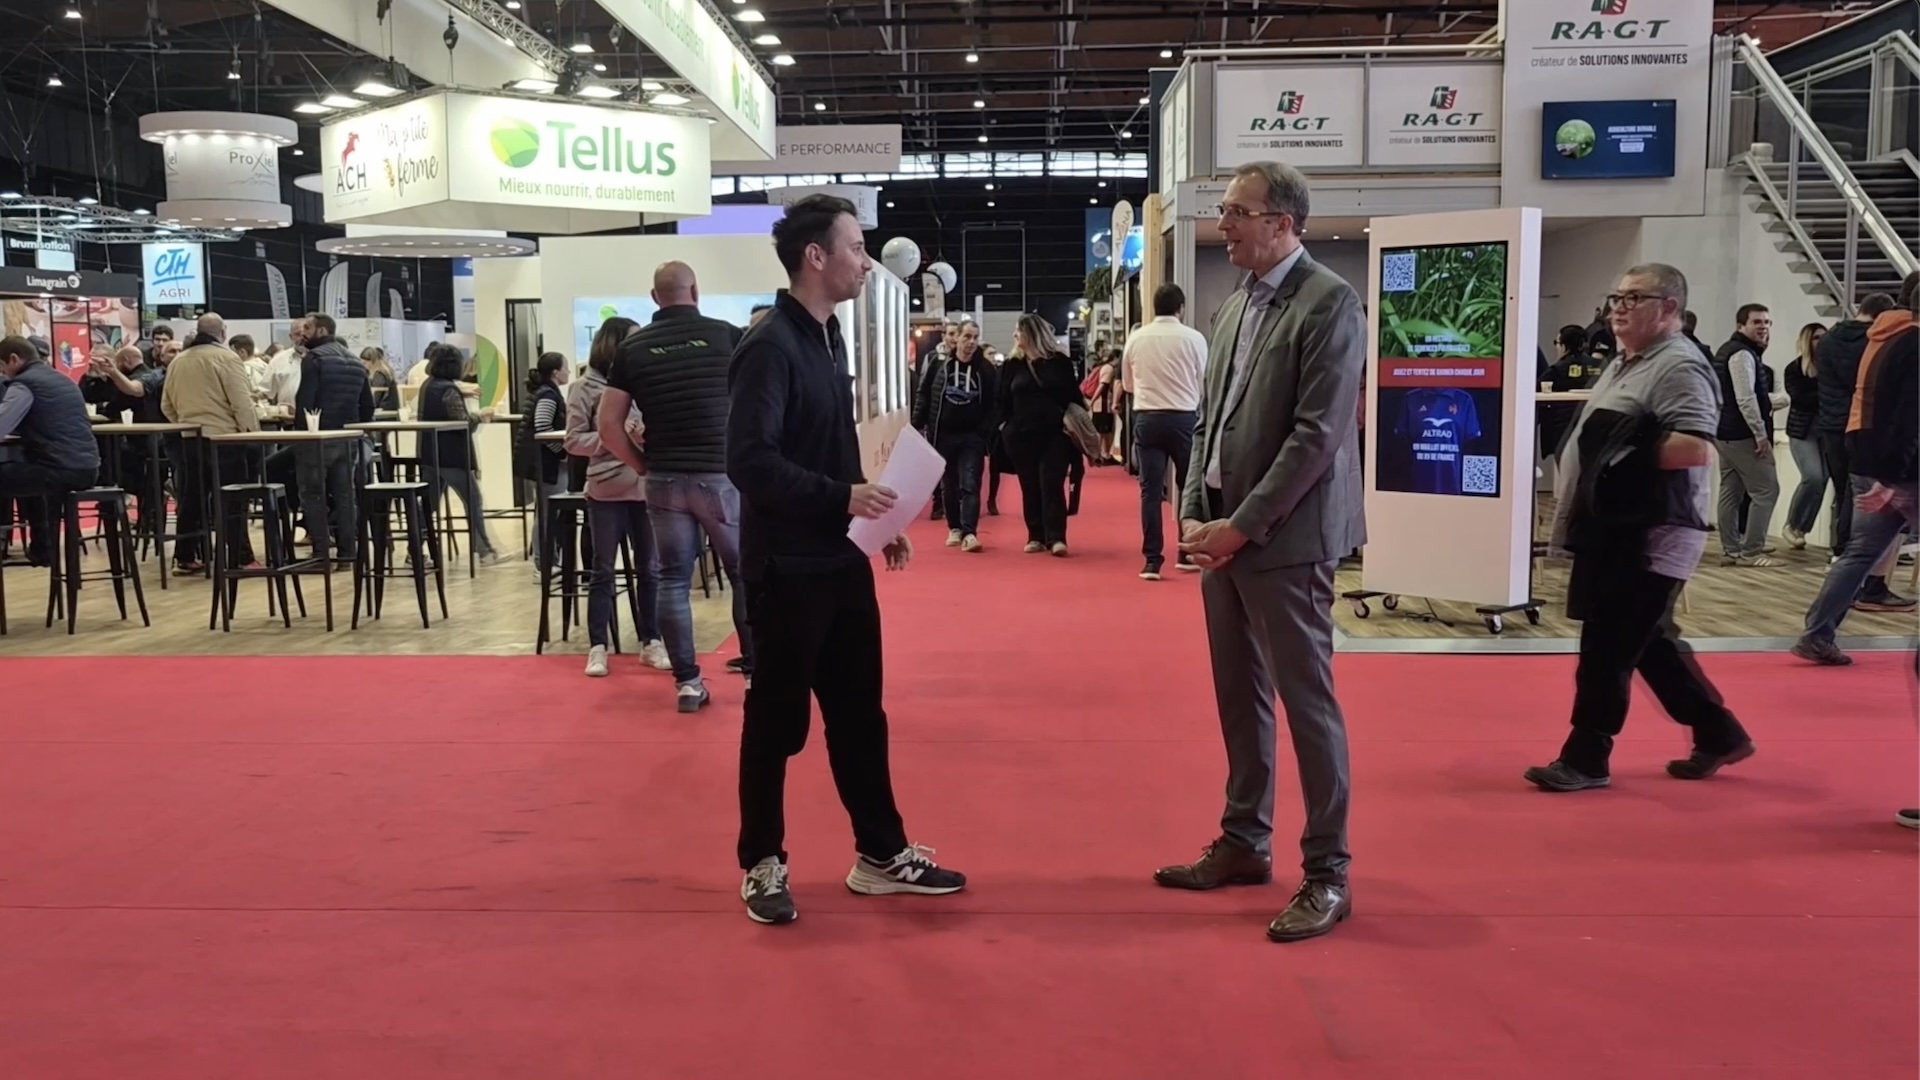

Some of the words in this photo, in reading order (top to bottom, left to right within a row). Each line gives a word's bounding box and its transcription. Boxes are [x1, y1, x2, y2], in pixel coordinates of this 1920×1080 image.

[1531, 55, 1565, 68] créateur
[1567, 55, 1578, 67] de
[1579, 53, 1629, 66] SOLUTIONS
[1631, 53, 1688, 65] INNOVANTES
[1269, 139, 1304, 149] SOLUTIONS
[1304, 139, 1343, 148] INNOVANTES
[1421, 135, 1456, 144] SOLUTIONS
[1456, 135, 1496, 143] INNOVANTES
[545, 120, 677, 177] Tellus
[790, 142, 892, 156] PERFORMANCE
[336, 162, 368, 194] ACH
[397, 152, 439, 198] ferme
[499, 177, 542, 195] Mieux
[545, 183, 592, 200] nourrir,
[595, 184, 676, 203] durablement
[9, 237, 71, 251] Brumisation
[26, 274, 68, 291] Limagrain
[159, 288, 191, 298] AGRI
[1422, 429, 1453, 438] ALTRAD
